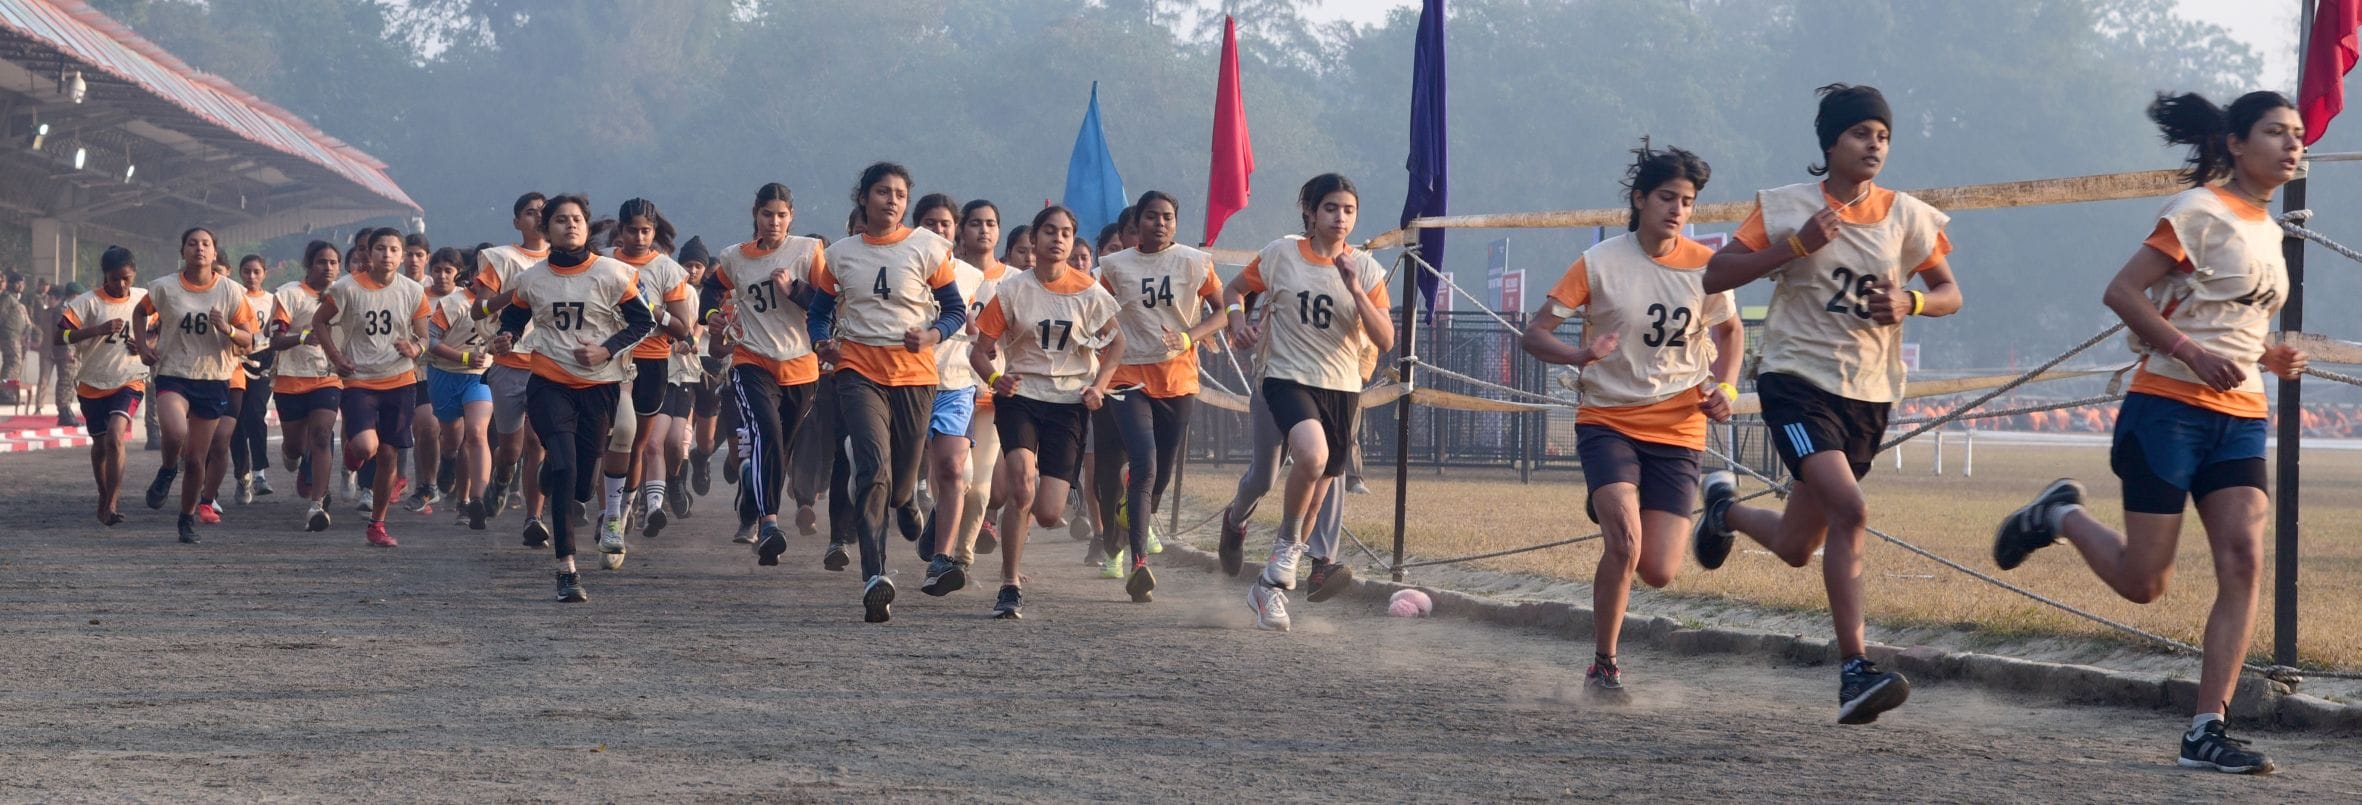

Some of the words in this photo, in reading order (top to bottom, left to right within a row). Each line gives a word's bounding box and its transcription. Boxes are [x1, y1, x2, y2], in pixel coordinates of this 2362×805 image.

[748, 280, 777, 313] 37
[873, 266, 891, 300] 4
[1141, 275, 1174, 308] 54
[180, 312, 208, 335] 46
[365, 309, 392, 336] 33
[553, 302, 584, 331] 57
[1296, 290, 1333, 329] 16
[1643, 303, 1692, 347] 32
[1037, 319, 1073, 350] 17
